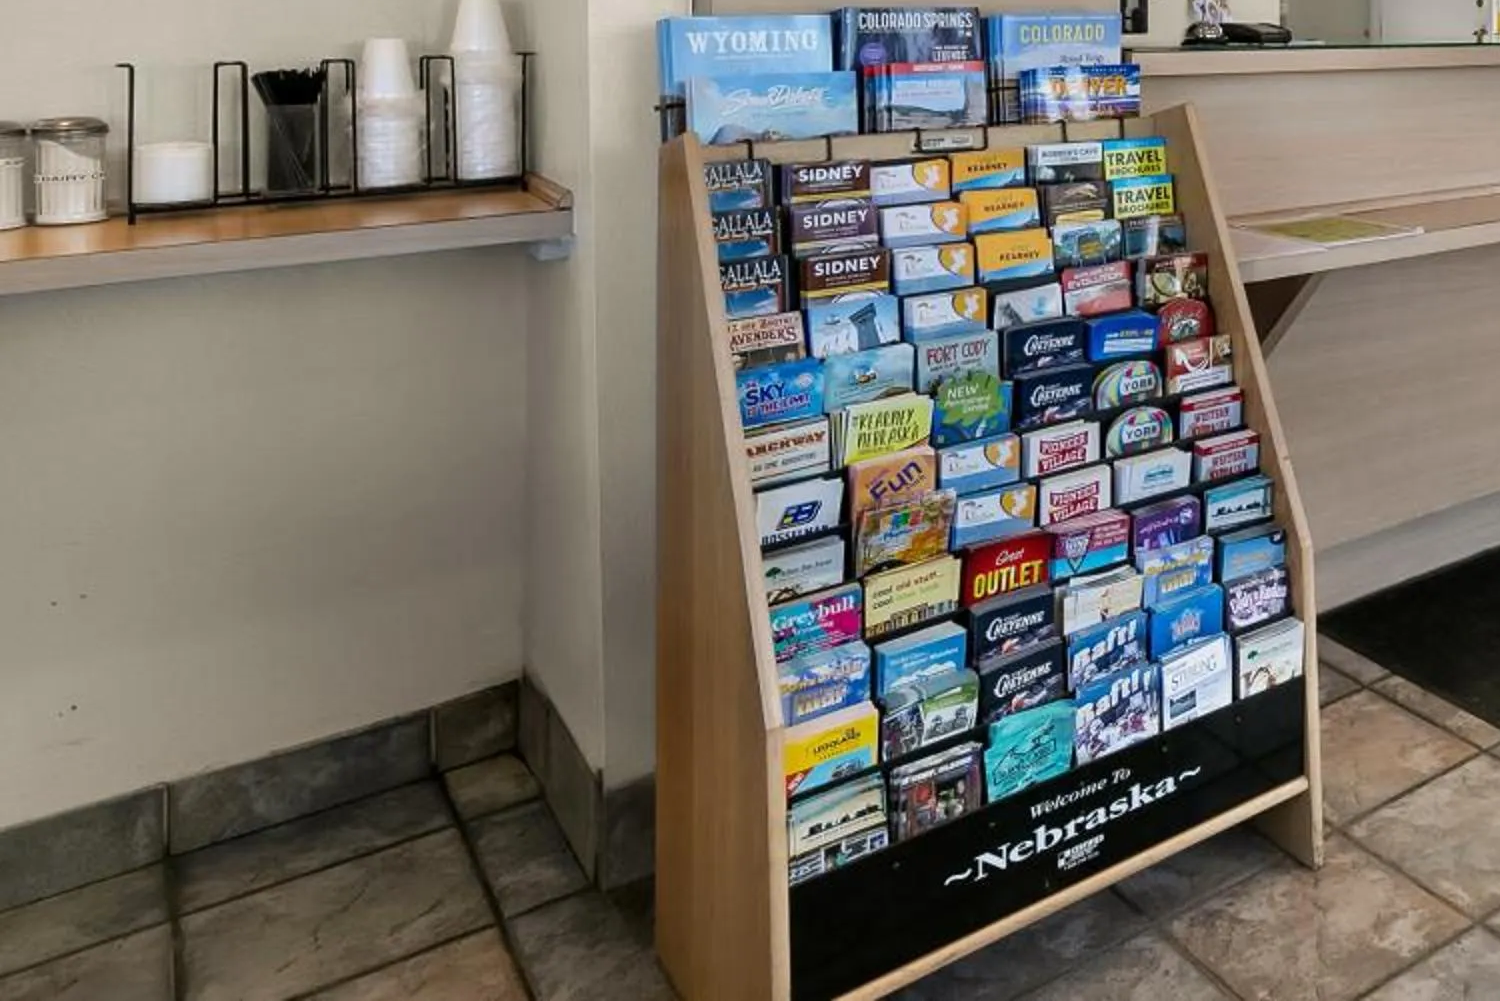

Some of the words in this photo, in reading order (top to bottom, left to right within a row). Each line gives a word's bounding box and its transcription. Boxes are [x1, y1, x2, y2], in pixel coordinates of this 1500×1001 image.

[858, 12, 921, 30] COLORADO
[922, 12, 974, 28] SPRINGS
[686, 29, 818, 55] WYOMING
[1020, 23, 1105, 44] COLORADO
[1105, 150, 1163, 166] TRAVEL
[799, 165, 863, 183] SIDNEY
[1116, 186, 1171, 204] TRAVEL
[803, 209, 868, 229] SIDNEY
[814, 255, 881, 277] SIDNEY
[927, 343, 958, 366] FORT
[745, 381, 785, 406] SKY
[1040, 449, 1086, 473] VILLAGE
[869, 460, 923, 500] Fun
[1051, 498, 1098, 523] VILLAGE
[973, 558, 1044, 599] OUTLET
[773, 595, 855, 632] Greybull
[1030, 776, 1107, 819] Welcome
[1111, 767, 1131, 786] To
